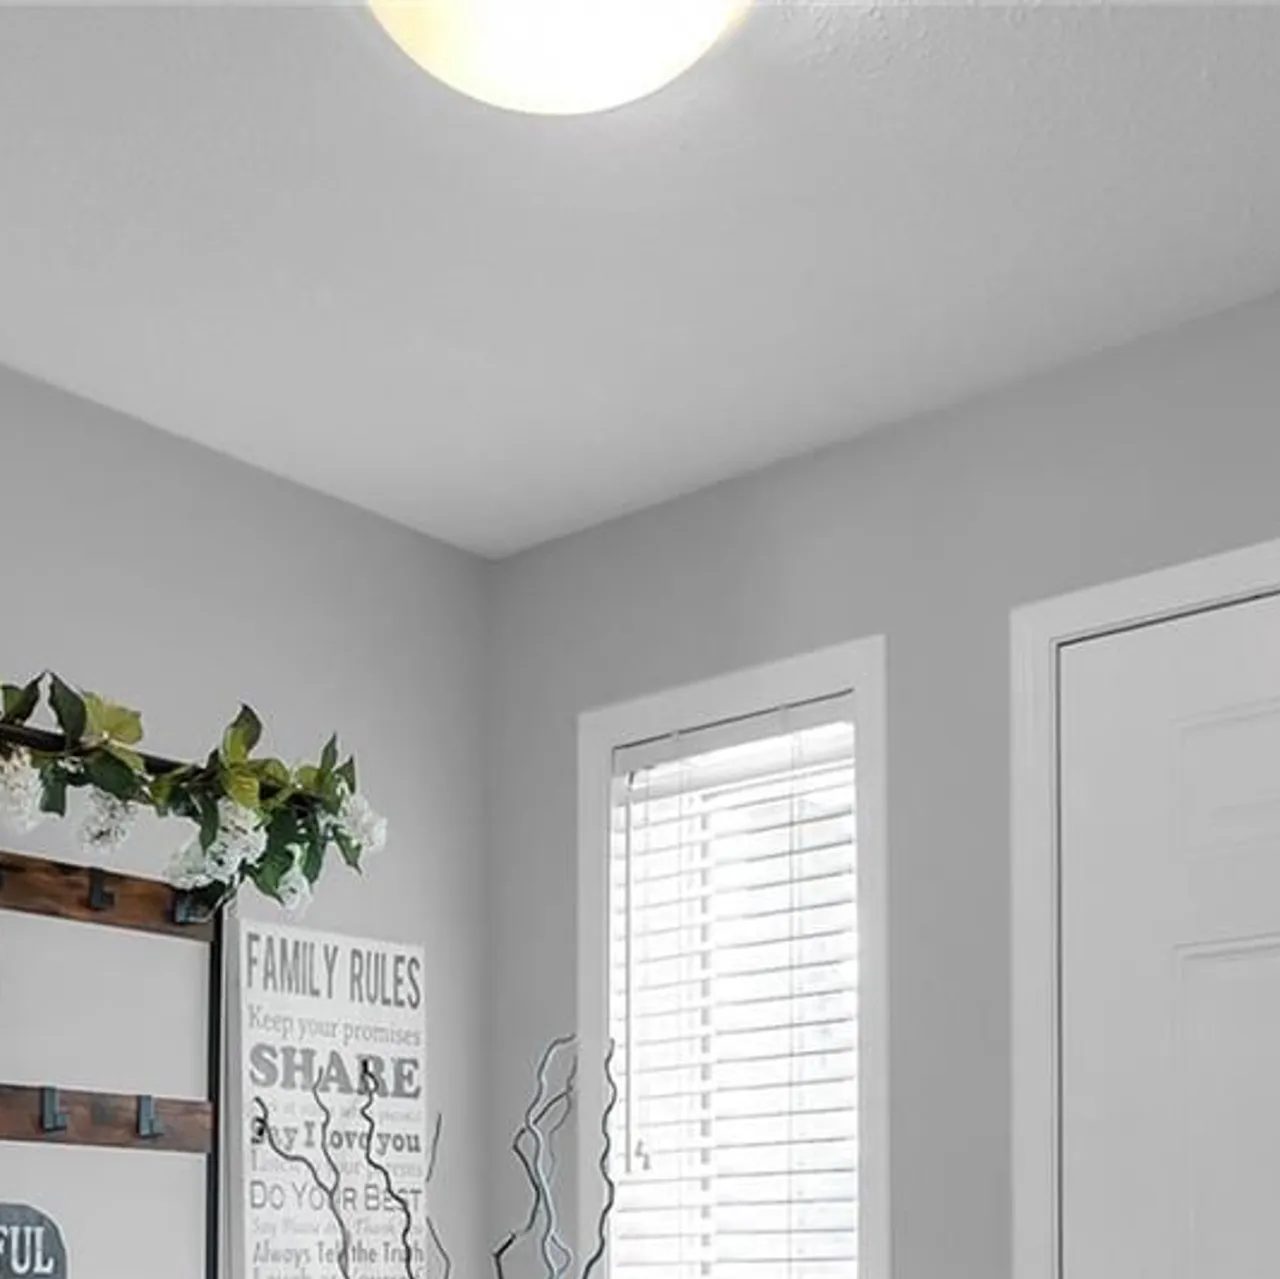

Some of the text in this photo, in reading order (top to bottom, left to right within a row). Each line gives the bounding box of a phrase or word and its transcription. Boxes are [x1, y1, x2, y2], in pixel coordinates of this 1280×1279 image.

[247, 932, 422, 1010] FAMILY RULES
[248, 1003, 295, 1041] Keep
[249, 1043, 422, 1099] SHARE
[375, 1132, 422, 1156] you
[250, 1180, 286, 1210] DO
[291, 1182, 358, 1212] YOR
[351, 1239, 378, 1263] the
[382, 1240, 424, 1264] Truh
